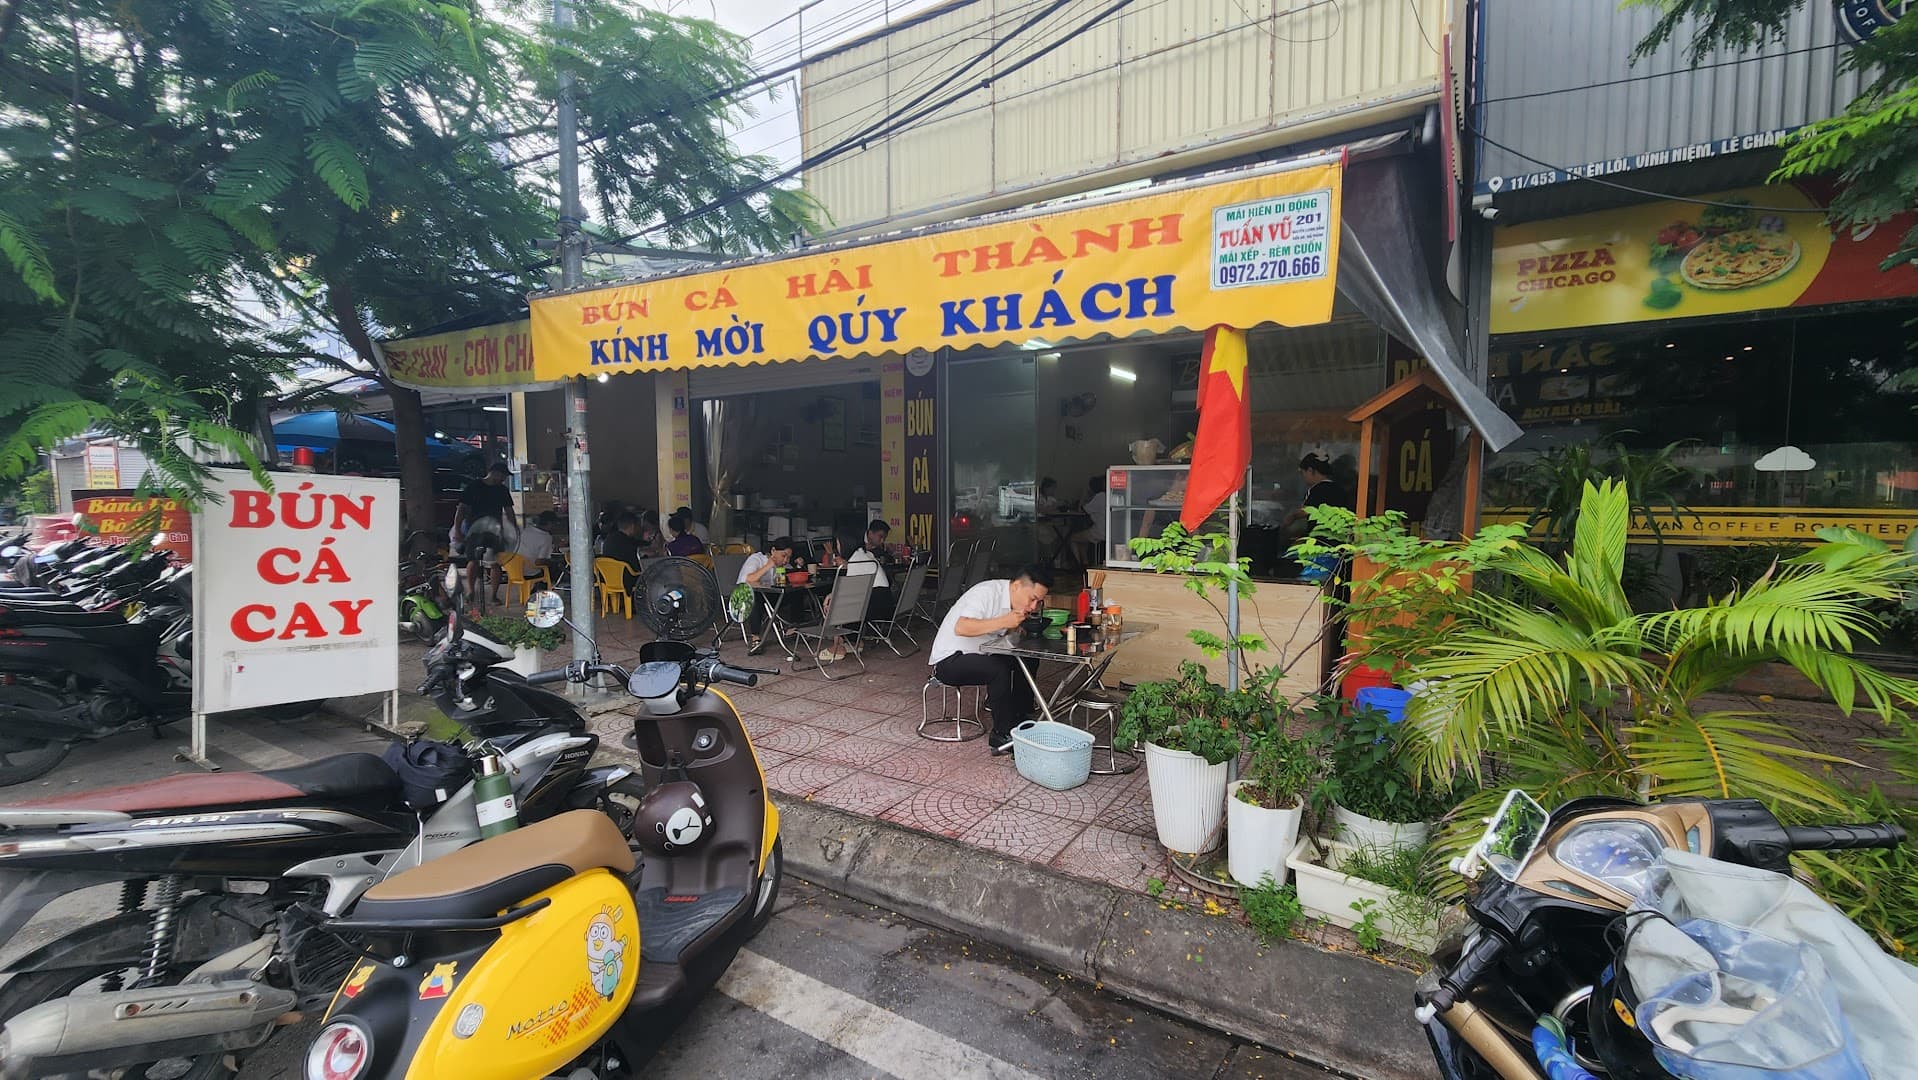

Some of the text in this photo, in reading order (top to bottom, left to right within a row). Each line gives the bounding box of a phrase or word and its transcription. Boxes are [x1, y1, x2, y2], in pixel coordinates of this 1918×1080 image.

[1511, 171, 1556, 190] 11/453
[1635, 151, 1669, 169] VĨNH
[1721, 137, 1740, 154] LÊ
[1226, 208, 1246, 221] MÁI
[1275, 203, 1286, 214] DI
[1288, 198, 1318, 213] ĐỘNG
[1220, 218, 1263, 249] TUẤN
[1268, 215, 1292, 242] VŨ
[1295, 212, 1322, 226] 201
[581, 213, 1184, 326] BÚN CÁ HẢI THÀNH
[1219, 251, 1238, 264] MÁI
[1240, 246, 1259, 261] XẾP
[1269, 244, 1291, 258] RÈM
[1220, 255, 1320, 285] 0972.270.666
[1516, 247, 1617, 276] PIZZA
[1516, 269, 1617, 292] CHICAGO
[589, 269, 1177, 366] KÍNH MỜI QÚY KHÁCH
[412, 343, 449, 379] CHAY
[464, 335, 499, 378] CƠM
[907, 390, 934, 437] BÚN
[912, 448, 930, 494] CÁ
[1400, 428, 1433, 493] CÁ
[228, 481, 376, 530] BÚN
[910, 513, 933, 551] CAY
[1693, 521, 1779, 532] COFFEE
[257, 536, 352, 584] CÁ
[230, 599, 374, 642] CAY
[564, 750, 590, 760] HONDA
[131, 815, 195, 828] AIR
[505, 1000, 568, 1040] Motto
